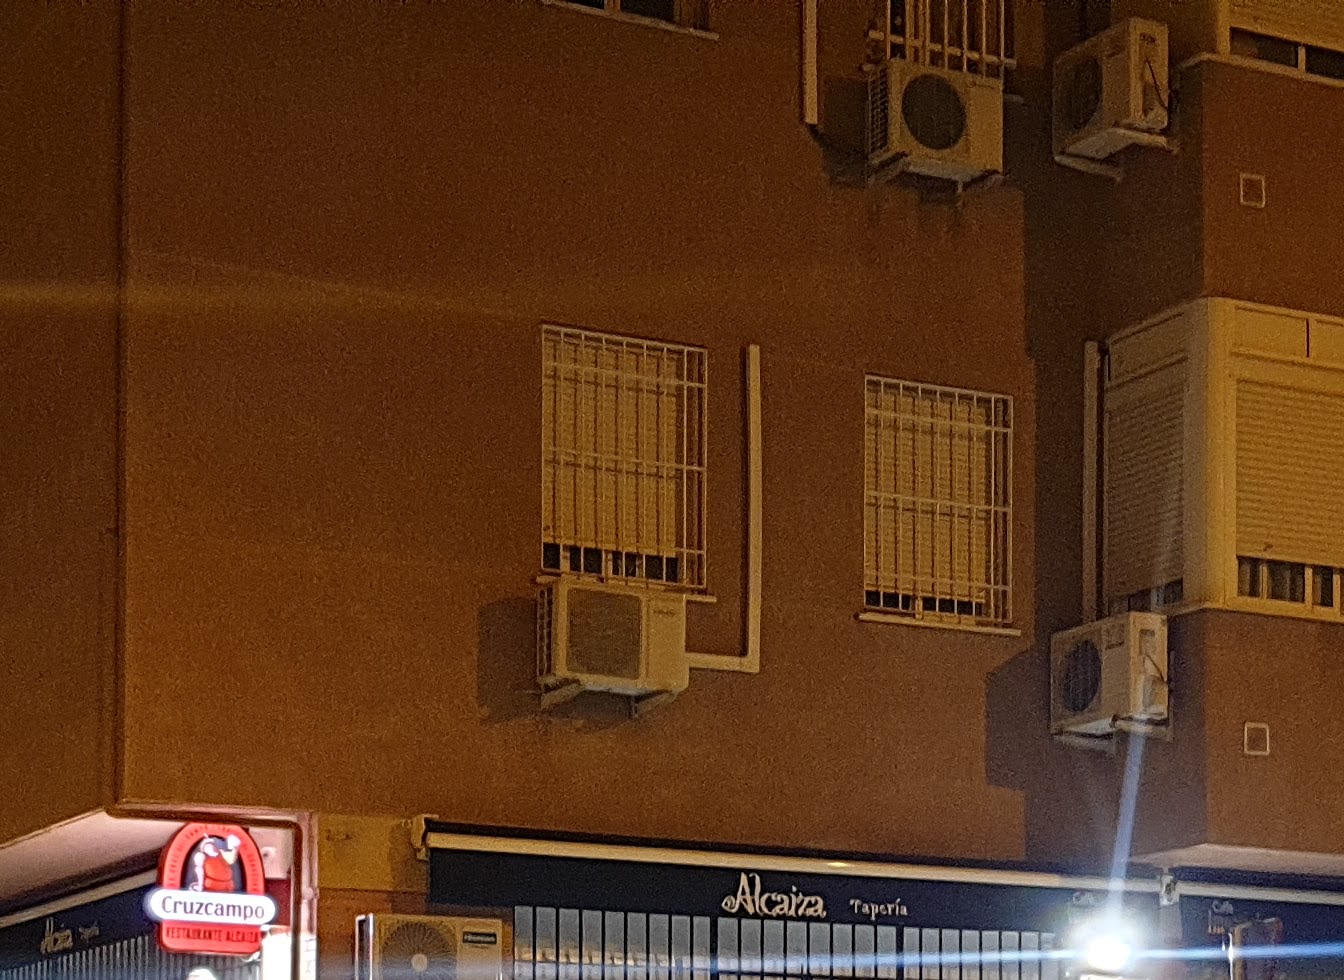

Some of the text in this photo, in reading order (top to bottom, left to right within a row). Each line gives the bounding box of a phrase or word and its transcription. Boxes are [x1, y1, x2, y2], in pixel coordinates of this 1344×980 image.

[161, 895, 265, 921] Cruzcampo
[720, 872, 908, 921] Alcaiza Tapería
[165, 926, 260, 944] RESTAURANTE ALCAIZA
